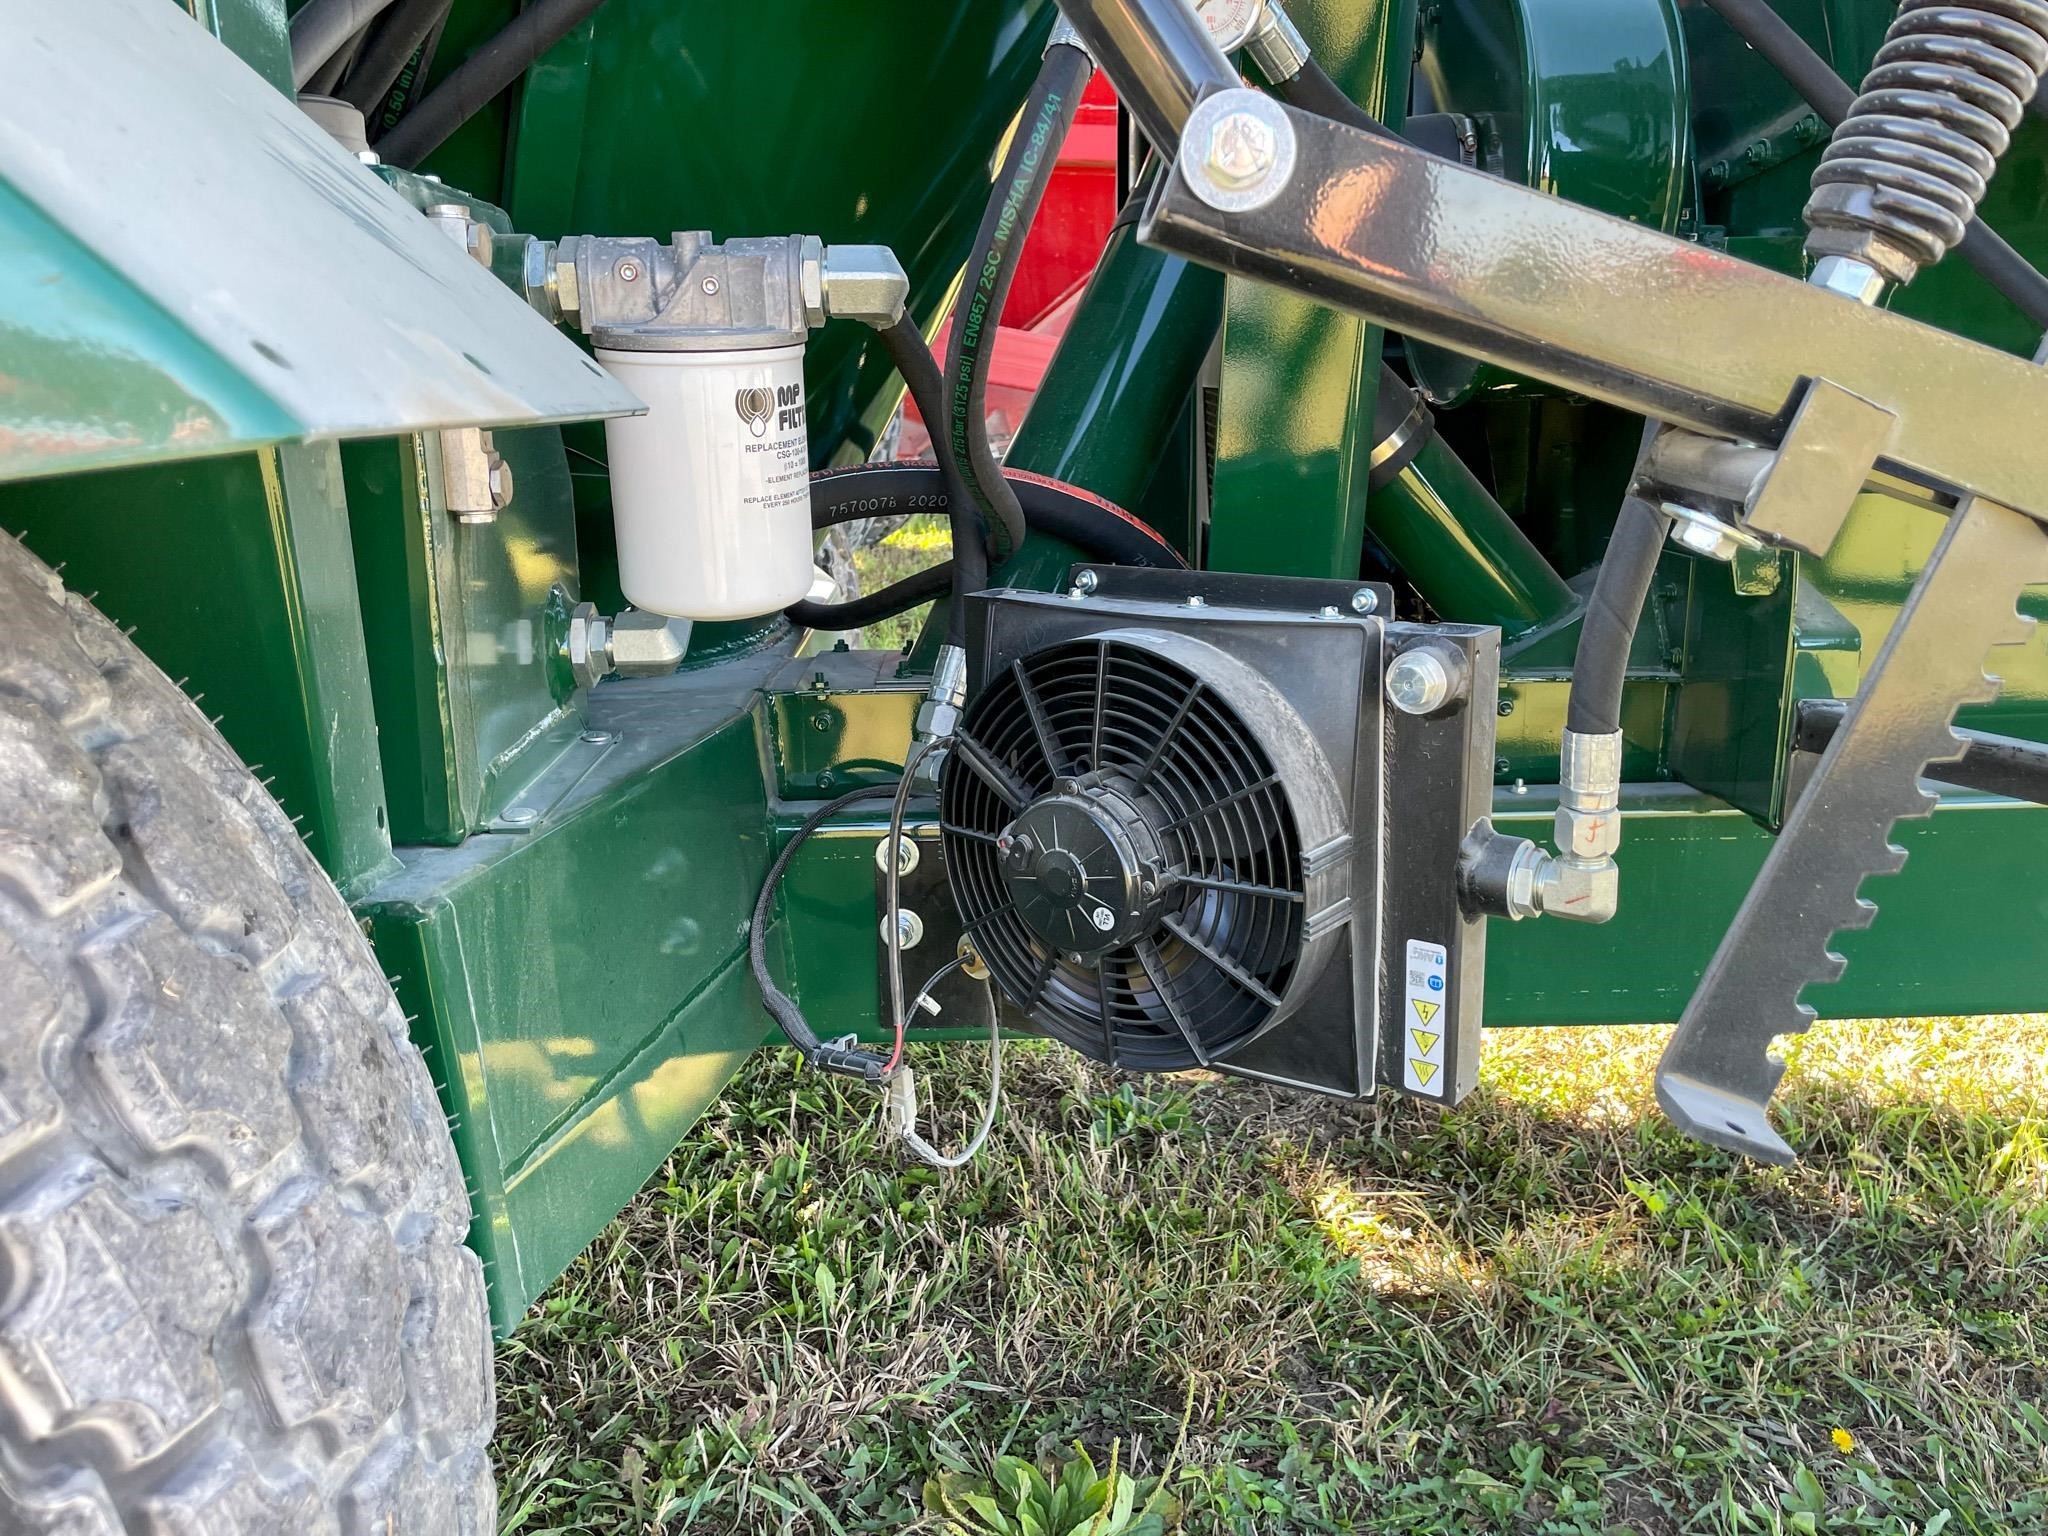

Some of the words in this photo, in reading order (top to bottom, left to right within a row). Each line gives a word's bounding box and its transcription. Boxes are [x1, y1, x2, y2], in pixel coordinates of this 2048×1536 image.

[994, 178, 1029, 241] MSHA
[979, 250, 1001, 291] 2SC
[963, 291, 989, 348] EN857
[960, 355, 975, 382] psi)
[777, 383, 799, 407] MP
[952, 384, 969, 417] (3125
[952, 419, 965, 437] bar
[745, 438, 798, 453] REPLACEMENT
[744, 494, 772, 504] REPLACE
[774, 490, 795, 501] ELEMENT
[763, 500, 782, 509] EVERY
[908, 495, 948, 507] 2020
